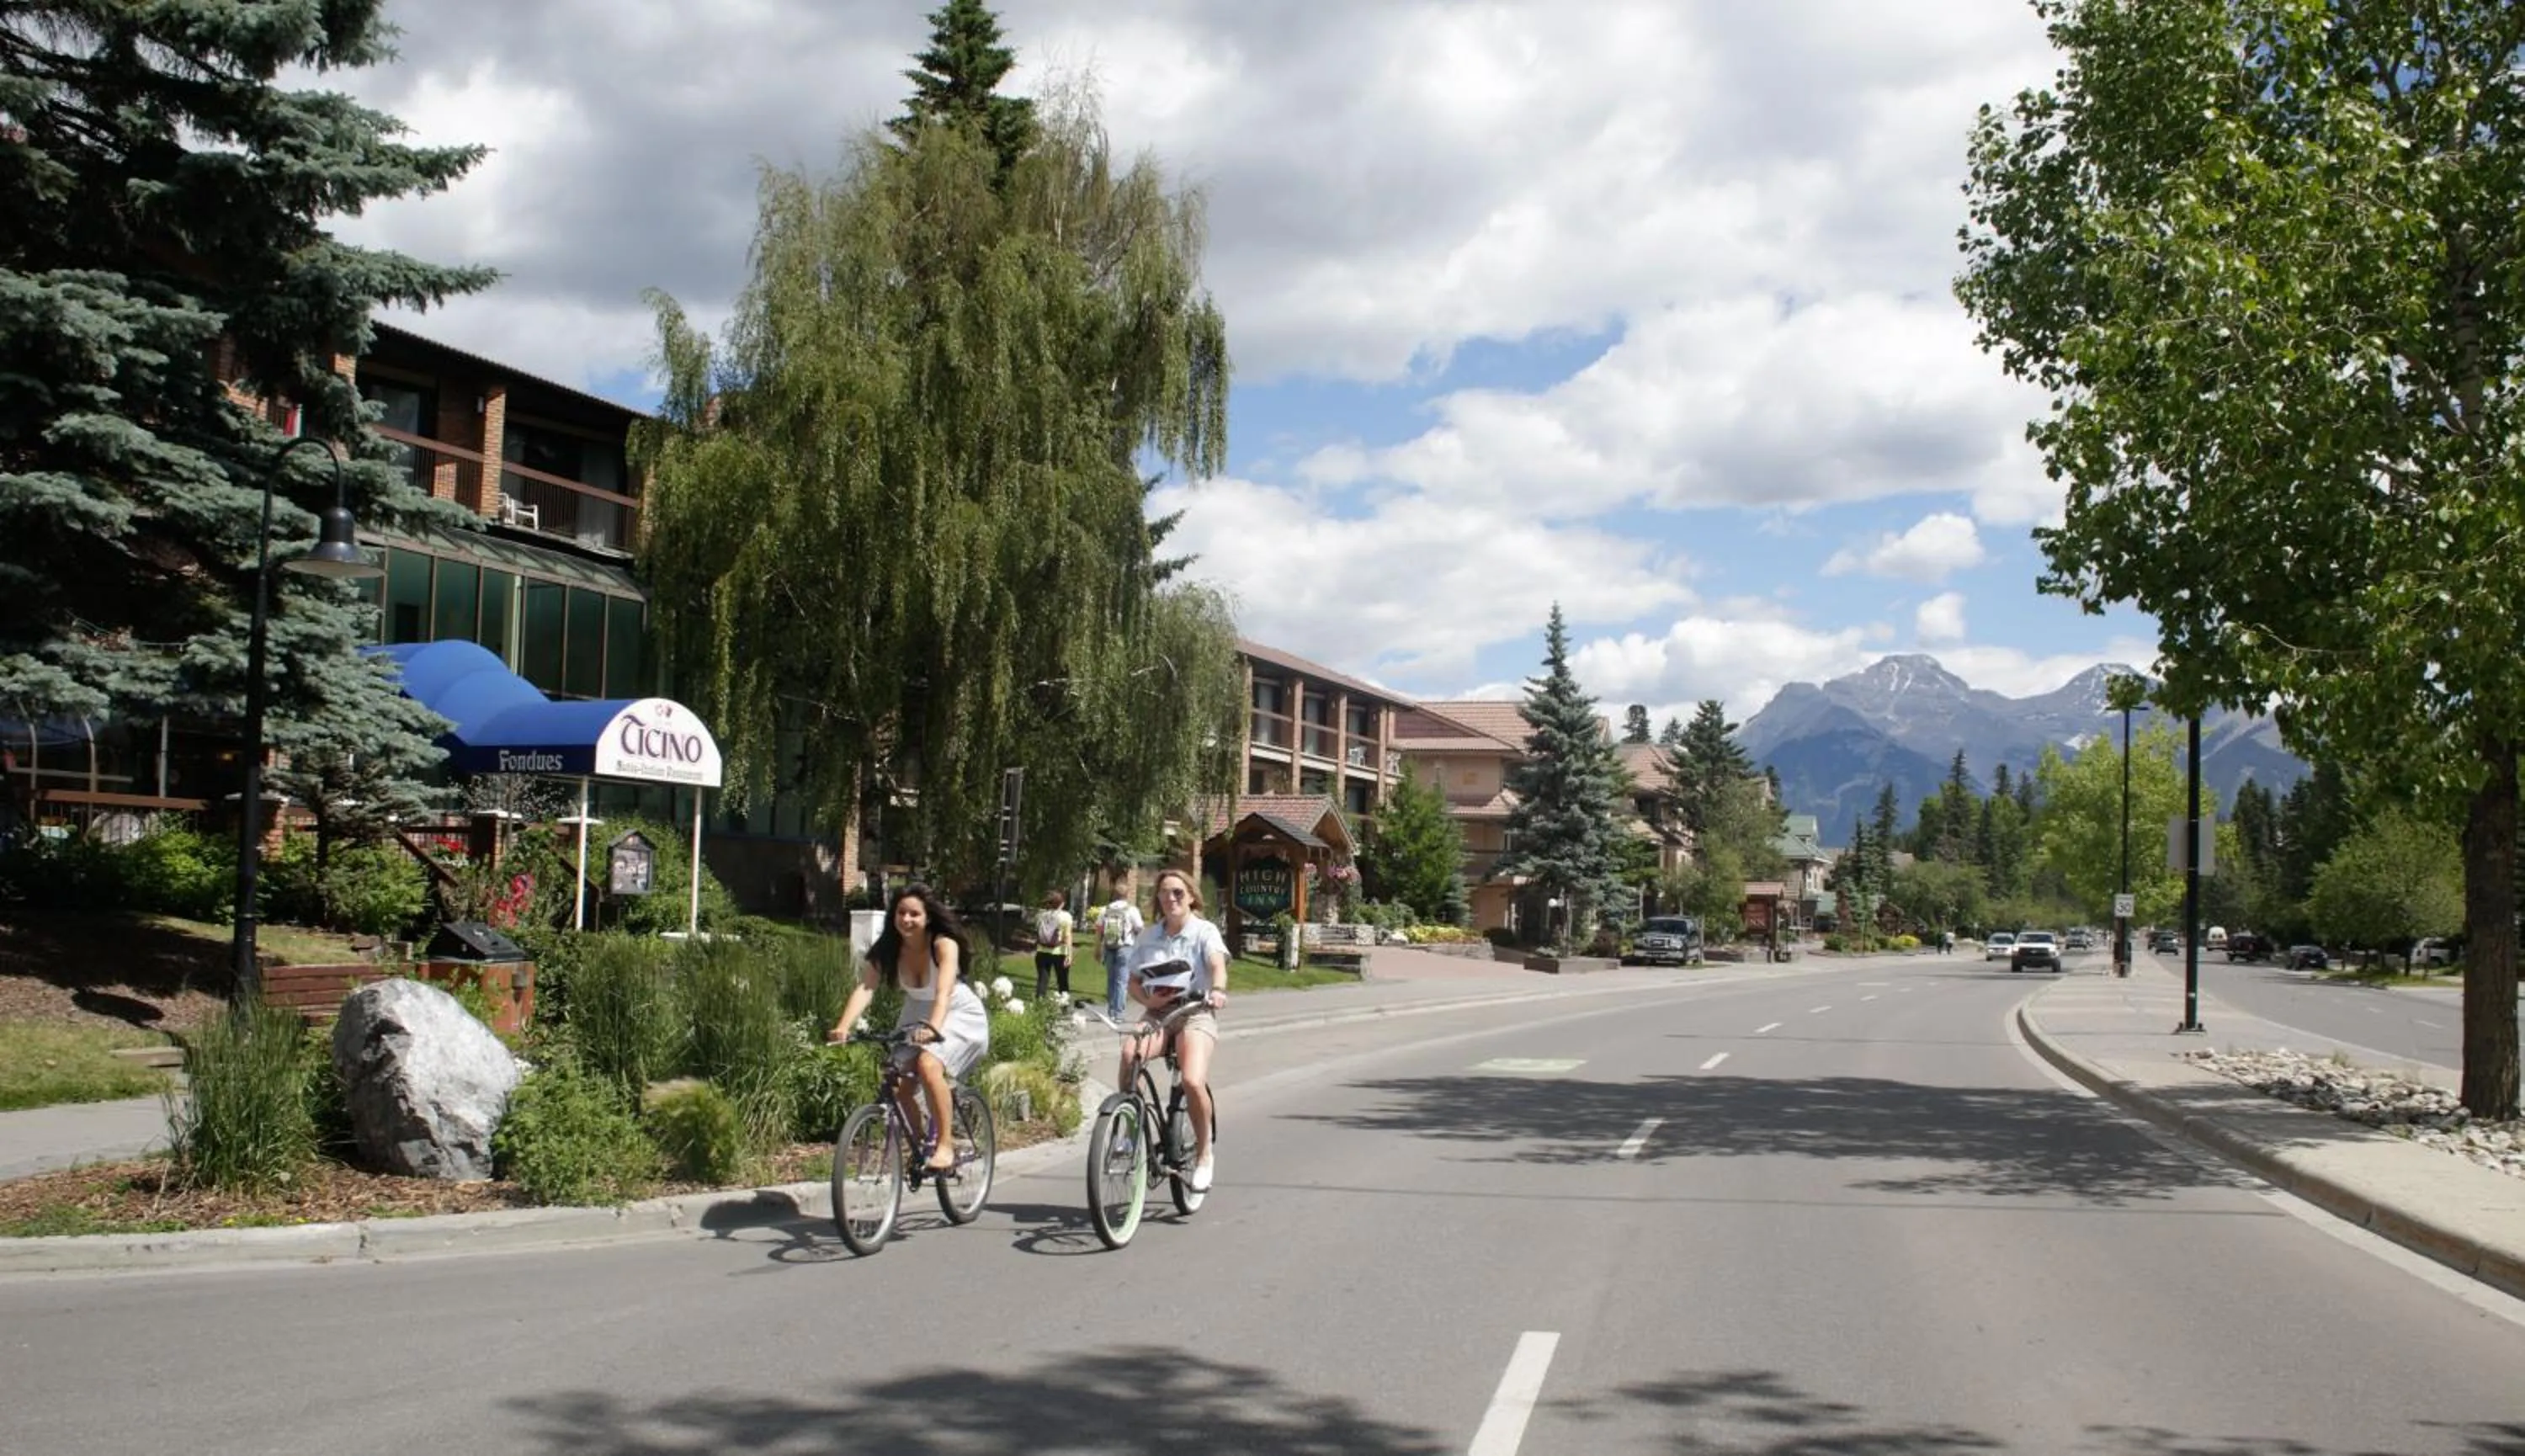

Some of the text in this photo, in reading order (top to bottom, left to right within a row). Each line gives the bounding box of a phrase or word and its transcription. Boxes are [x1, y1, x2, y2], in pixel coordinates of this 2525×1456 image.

[620, 715, 702, 763] TICINO
[498, 748, 564, 772] Fondues
[1239, 869, 1287, 885] HIGH
[2117, 901, 2132, 913] 30
